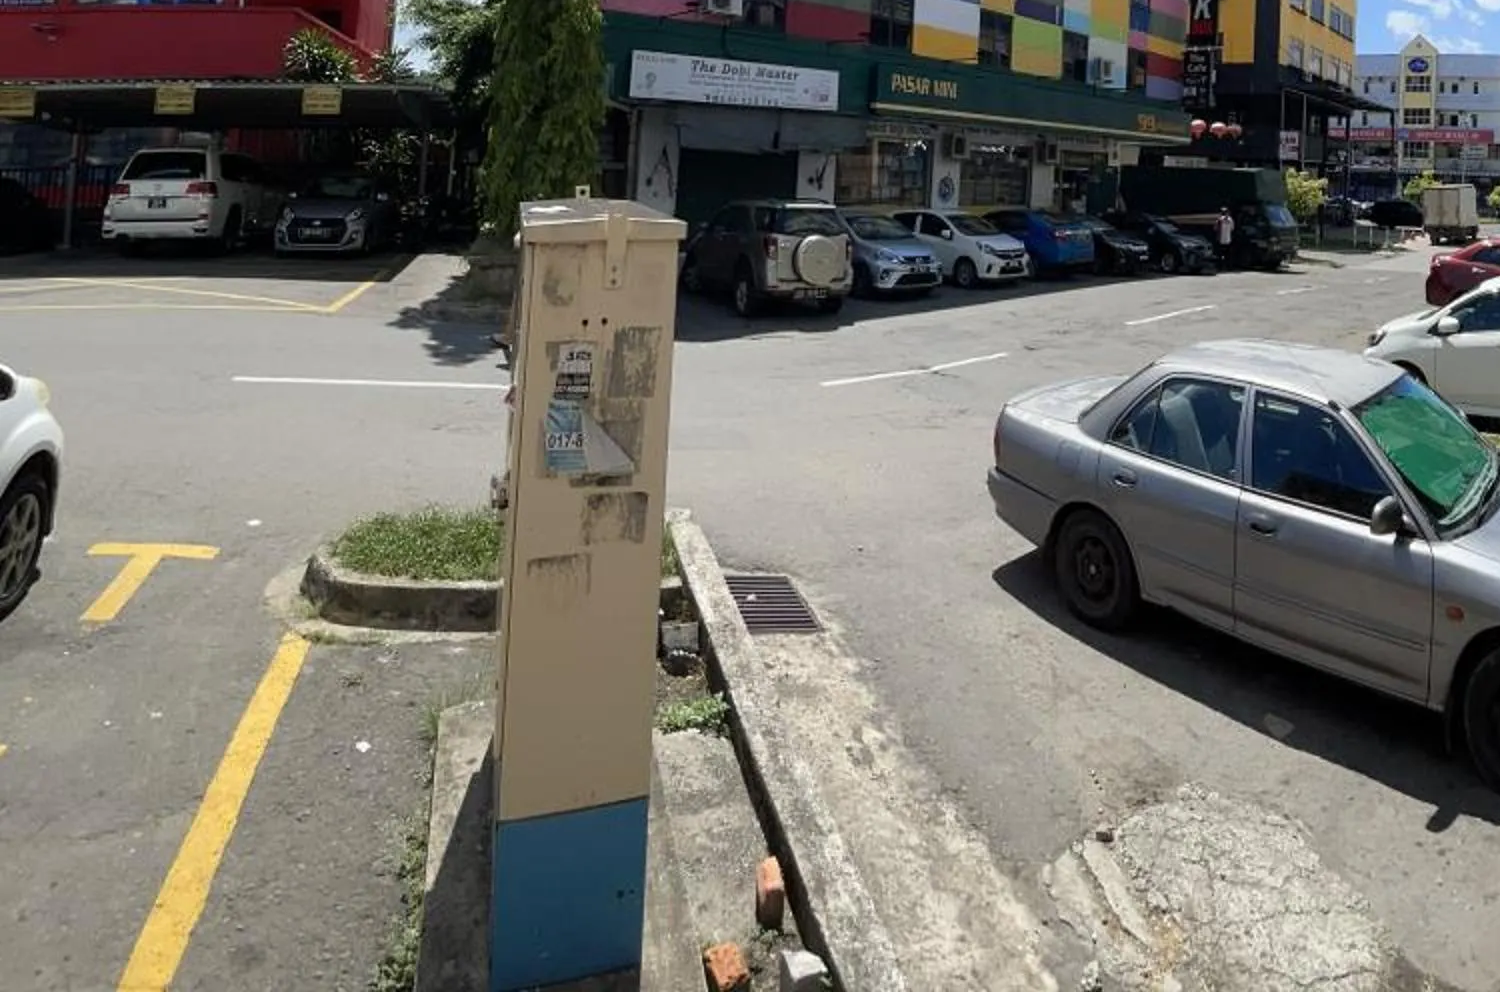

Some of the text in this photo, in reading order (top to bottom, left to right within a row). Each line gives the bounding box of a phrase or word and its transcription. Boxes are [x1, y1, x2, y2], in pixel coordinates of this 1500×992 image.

[690, 59, 801, 82] The Dobi Master
[891, 73, 931, 96] PASAR
